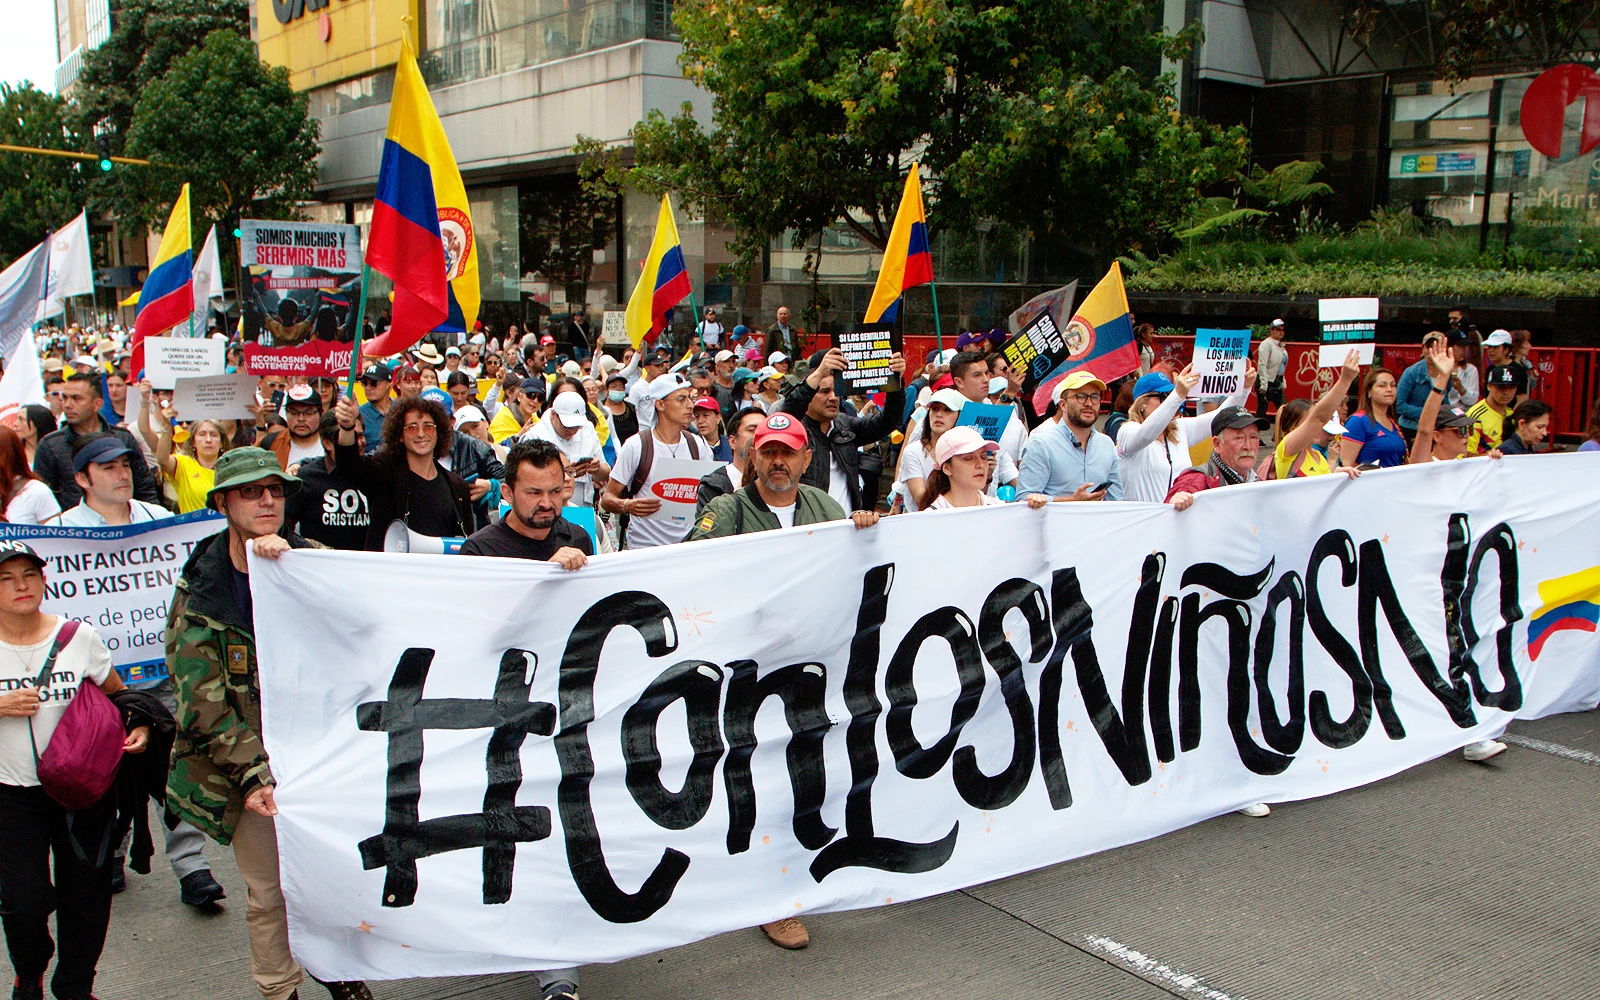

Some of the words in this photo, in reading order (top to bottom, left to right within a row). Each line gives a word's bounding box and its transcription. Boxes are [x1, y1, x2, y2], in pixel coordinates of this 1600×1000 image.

[255, 228, 293, 246] SOMOS
[294, 230, 337, 248] MUCHOS
[338, 232, 346, 248] Y
[256, 245, 315, 267] SEREMOS
[316, 246, 347, 269] MÁS
[269, 279, 278, 289] EN
[278, 279, 300, 288] DEFENSA
[301, 279, 307, 288] DE
[308, 279, 317, 288] LOS
[1037, 315, 1056, 339] CON
[1047, 332, 1064, 354] LOS
[1015, 333, 1032, 352] NO
[1210, 336, 1231, 349] DEJA
[1231, 337, 1244, 349] QUE
[250, 354, 322, 365] #CONLOSNIÑOS
[1023, 346, 1038, 363] SE
[1206, 348, 1222, 360] LOS
[250, 362, 307, 371] NOTEMETAS
[1214, 361, 1234, 373] SEAN
[1502, 368, 1513, 381] LA
[1200, 372, 1239, 394] NIÑOS
[662, 489, 675, 498] NO
[674, 491, 684, 499] TE
[679, 484, 694, 493] MIS
[322, 488, 369, 514] SOY
[321, 512, 371, 527] CRISTIAN
[43, 580, 77, 601] NO
